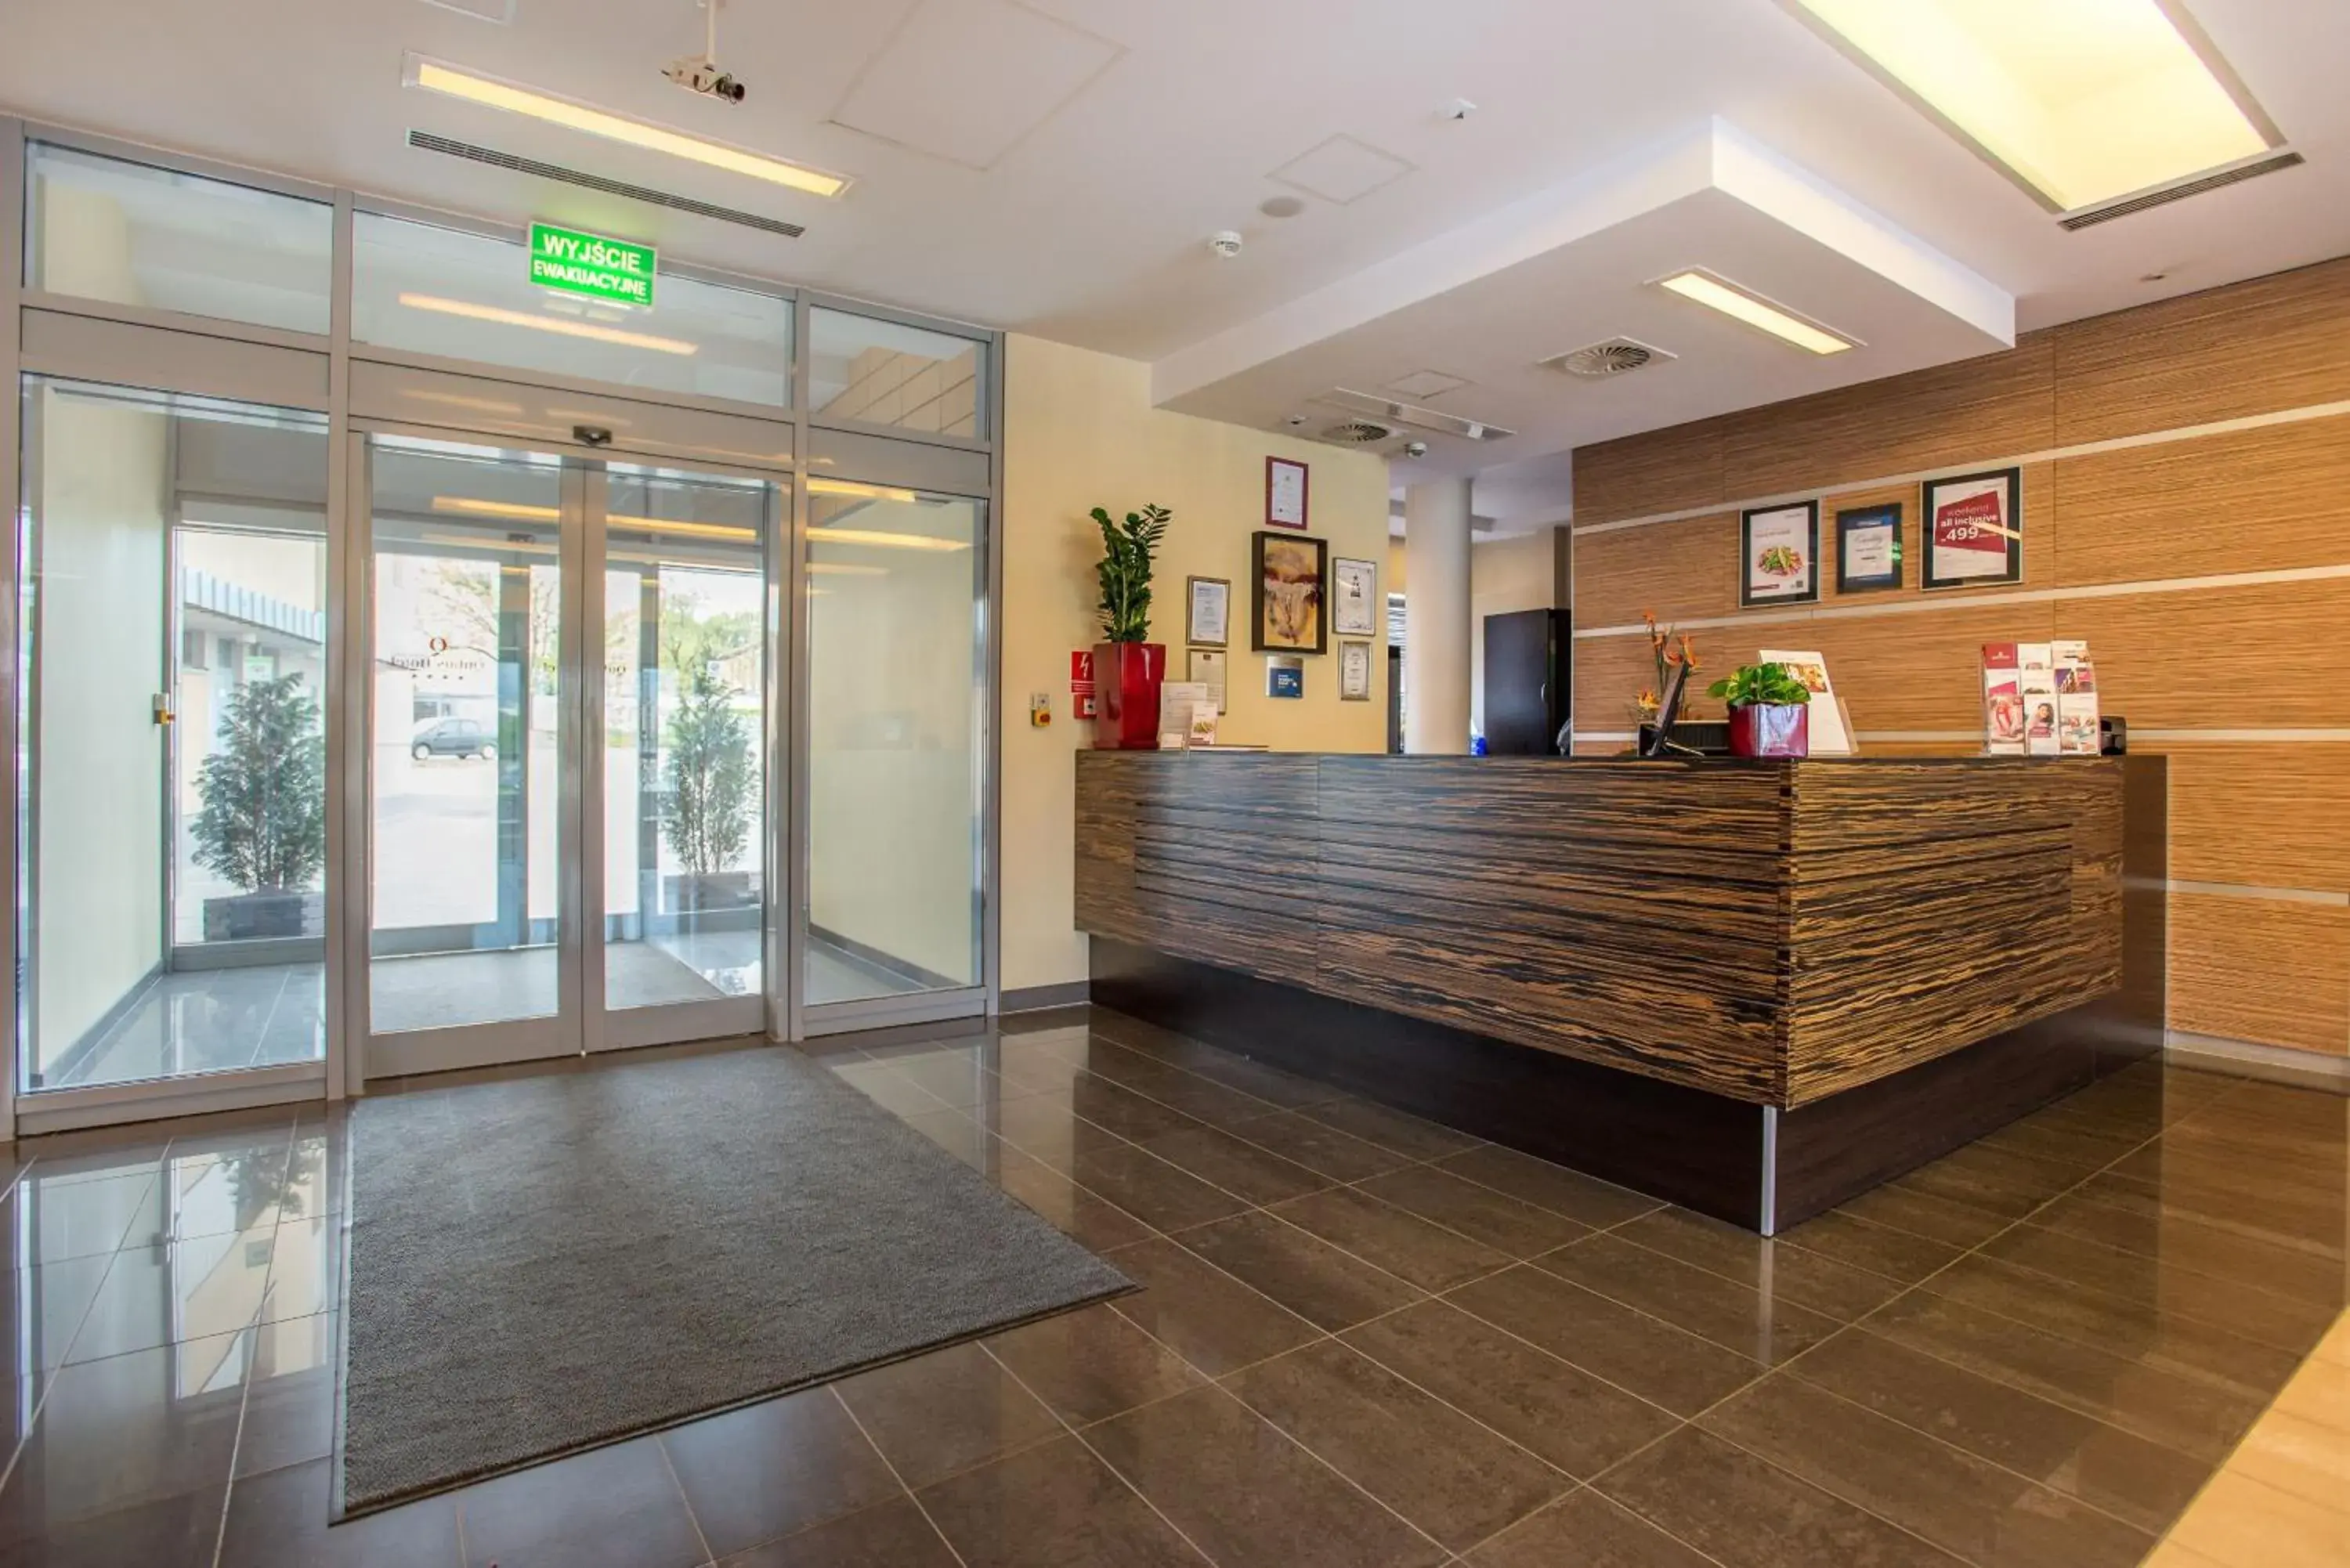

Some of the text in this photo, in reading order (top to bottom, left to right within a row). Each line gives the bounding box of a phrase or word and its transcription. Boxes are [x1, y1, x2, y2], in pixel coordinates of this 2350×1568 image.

[543, 233, 641, 272] WYJŚCIE
[533, 261, 646, 296] EWAKUACYJNE
[1940, 514, 1998, 527] all inclusive
[1946, 526, 1979, 541] 499
